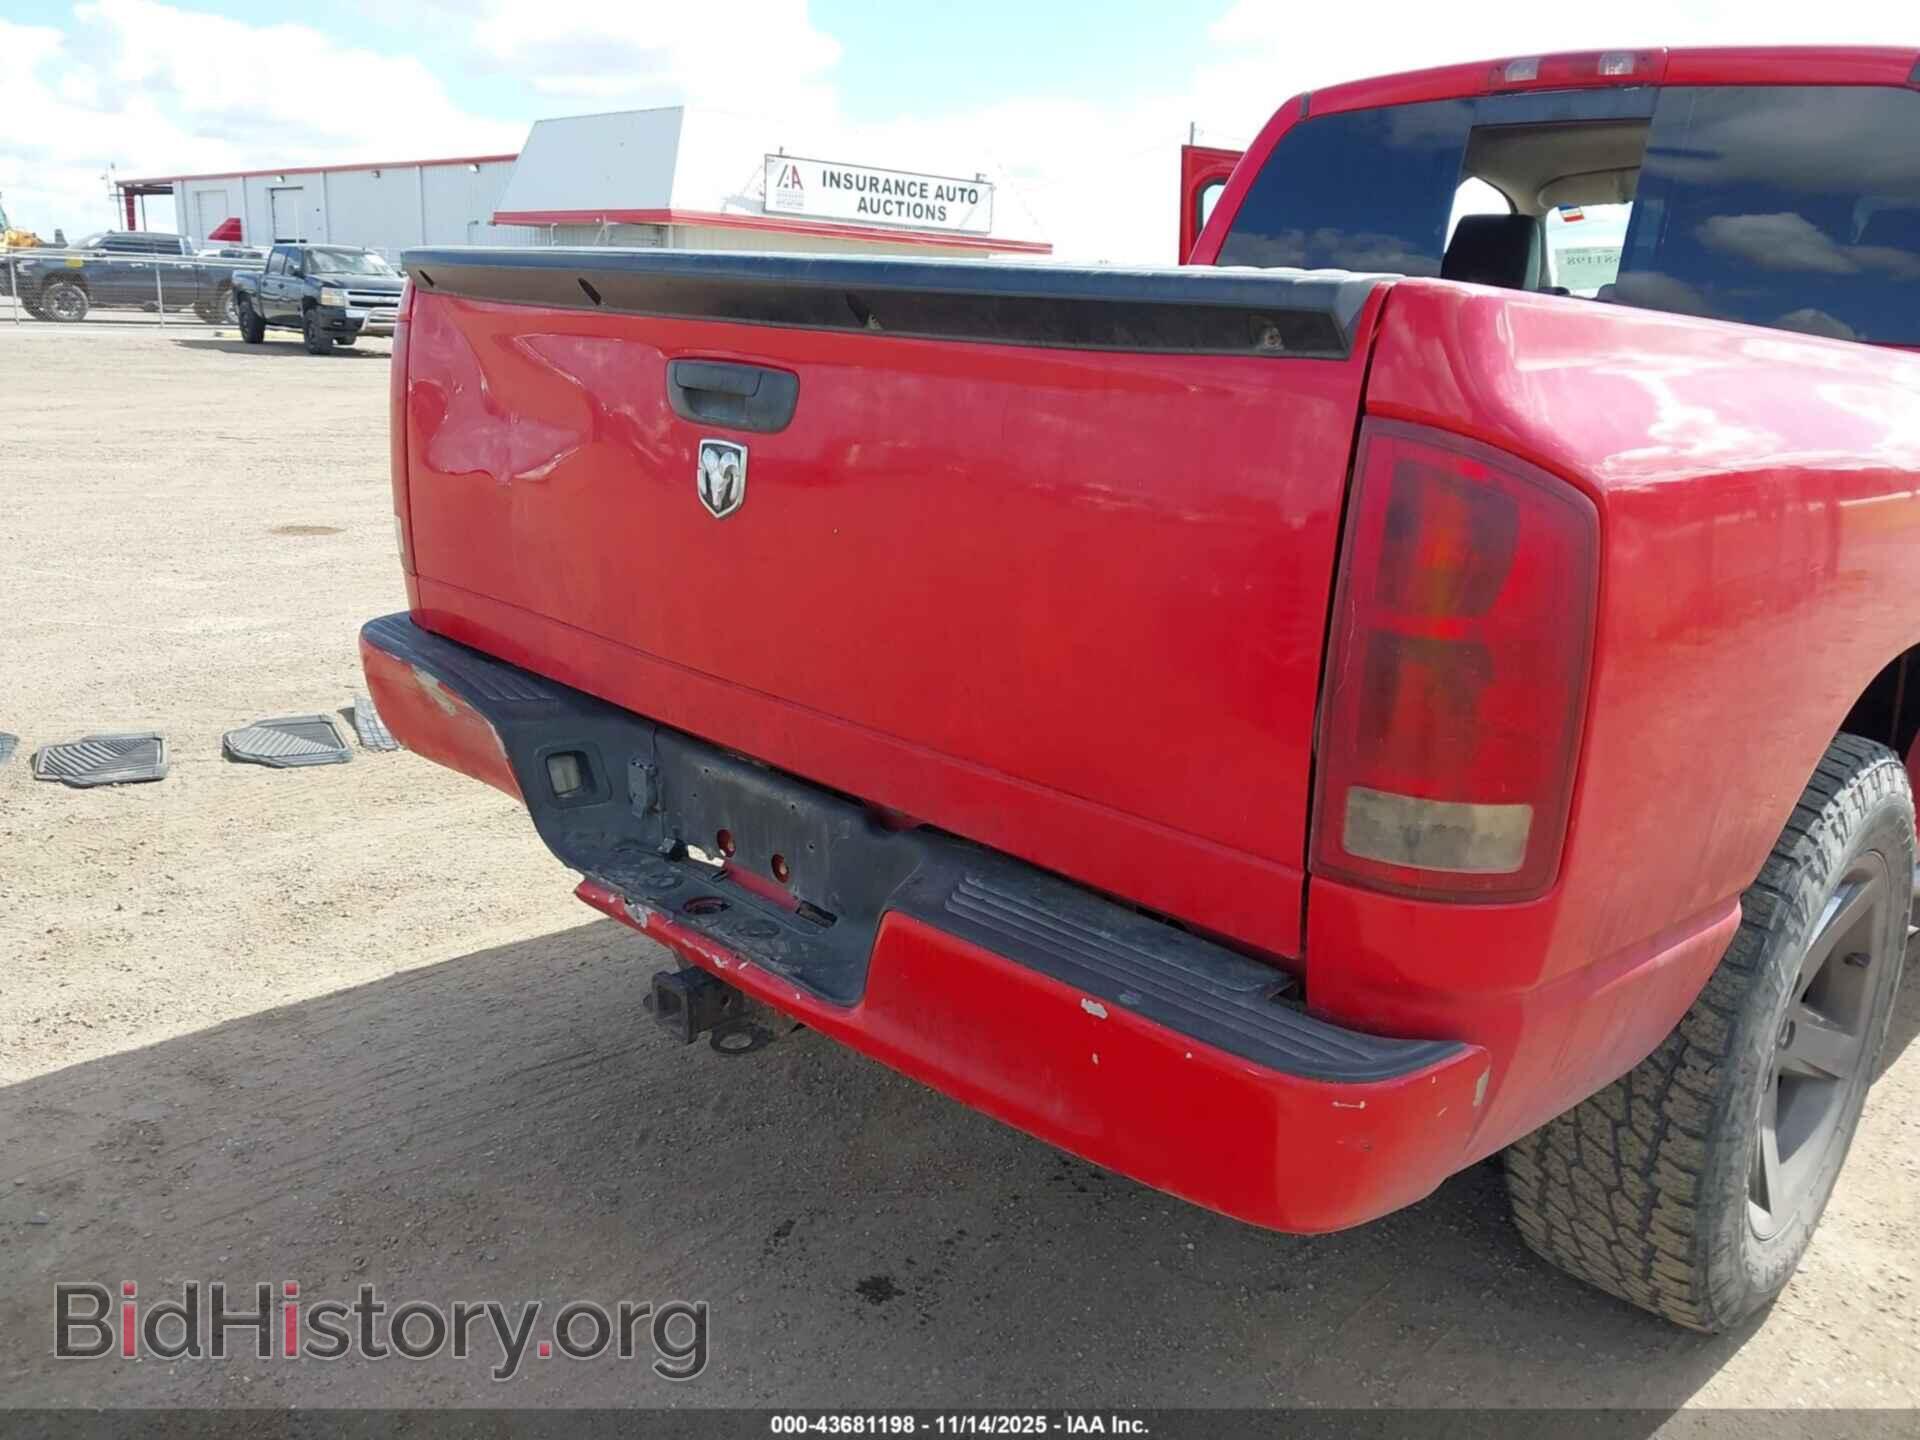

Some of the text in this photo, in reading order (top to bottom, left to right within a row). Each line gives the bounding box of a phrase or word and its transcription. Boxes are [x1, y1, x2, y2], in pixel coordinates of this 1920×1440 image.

[822, 170, 979, 205] INSURANCE AUTO
[857, 197, 947, 222] AUCTIONS
